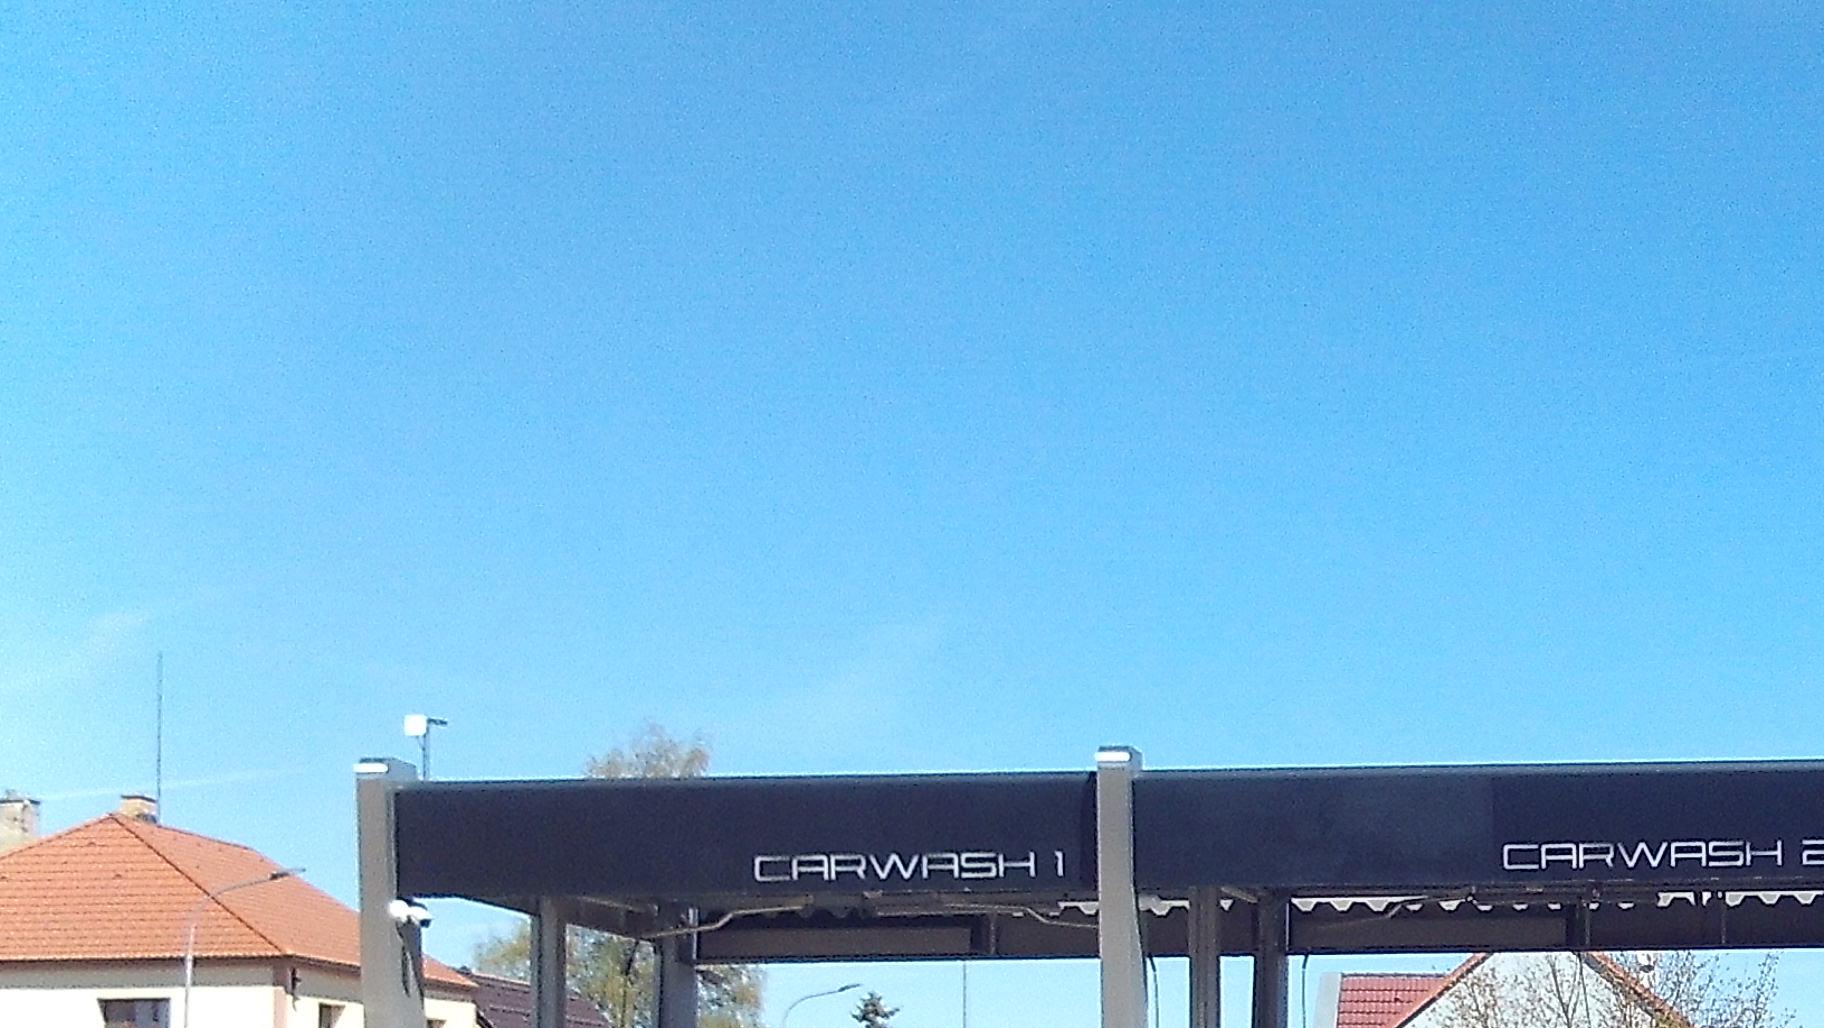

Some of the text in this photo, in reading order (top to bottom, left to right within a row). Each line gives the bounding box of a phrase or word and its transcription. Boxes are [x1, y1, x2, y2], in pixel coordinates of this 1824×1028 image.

[754, 850, 1065, 881] CARWASH 1
[1503, 839, 1783, 869] CARWASH
